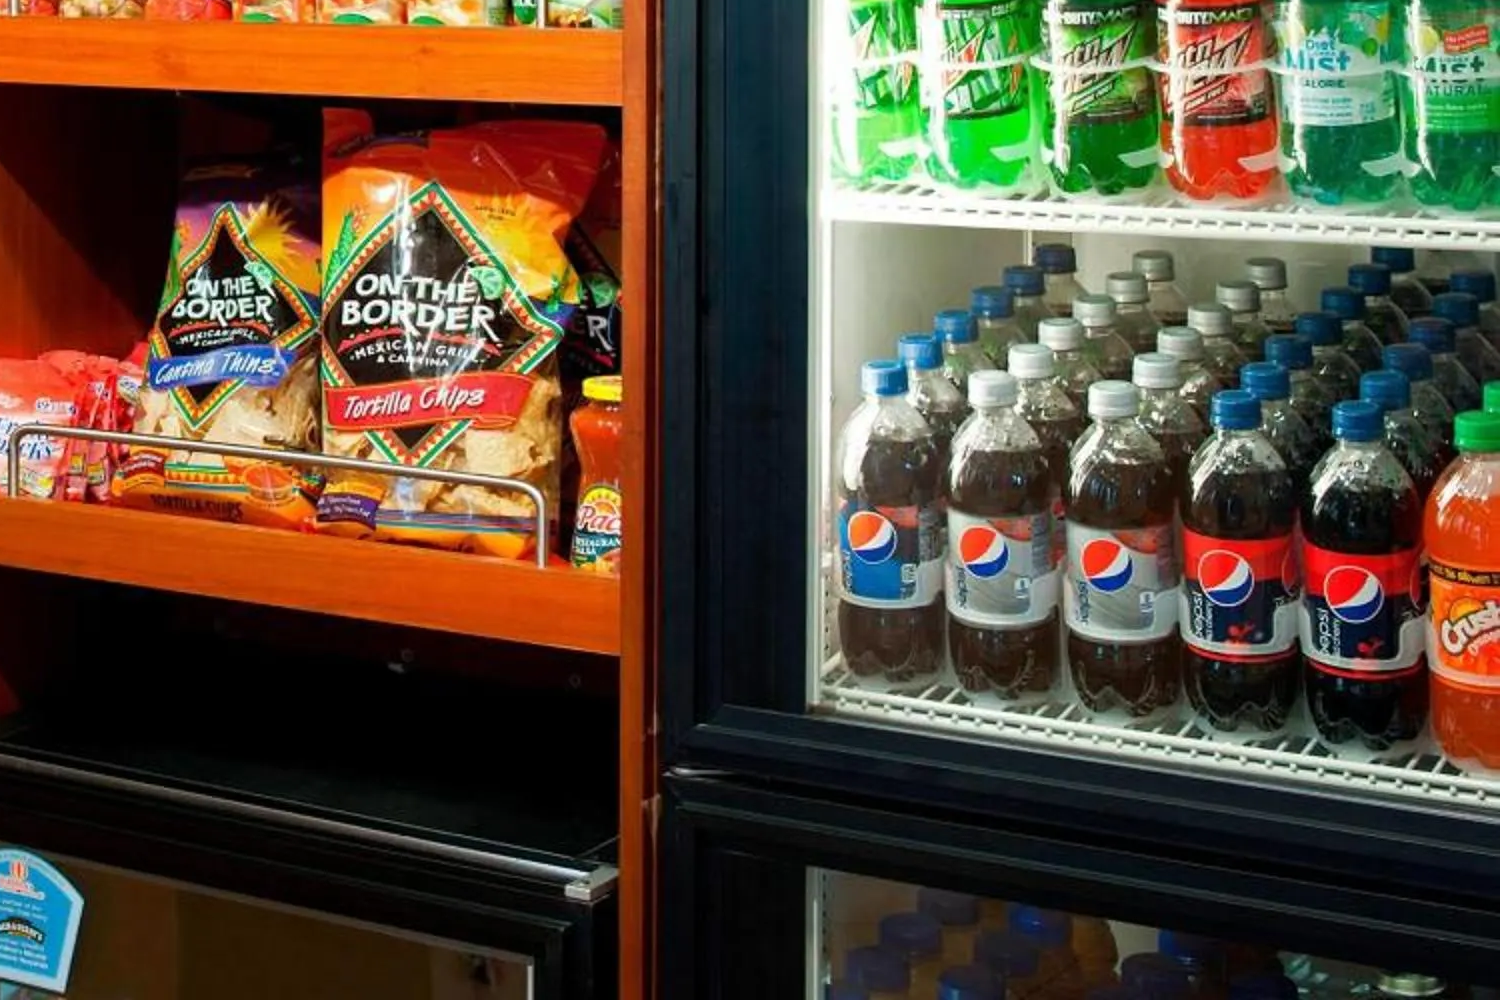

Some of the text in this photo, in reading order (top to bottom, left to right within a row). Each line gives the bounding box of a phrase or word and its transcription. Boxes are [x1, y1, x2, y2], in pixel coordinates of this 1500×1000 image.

[1304, 78, 1347, 89] ALORIE
[221, 277, 255, 298] THE
[355, 273, 479, 304] ON THE
[171, 295, 275, 328] BORDER
[341, 299, 501, 343] BORDER
[354, 340, 428, 360] MEXICAN
[344, 385, 486, 419] Tortilla Chips
